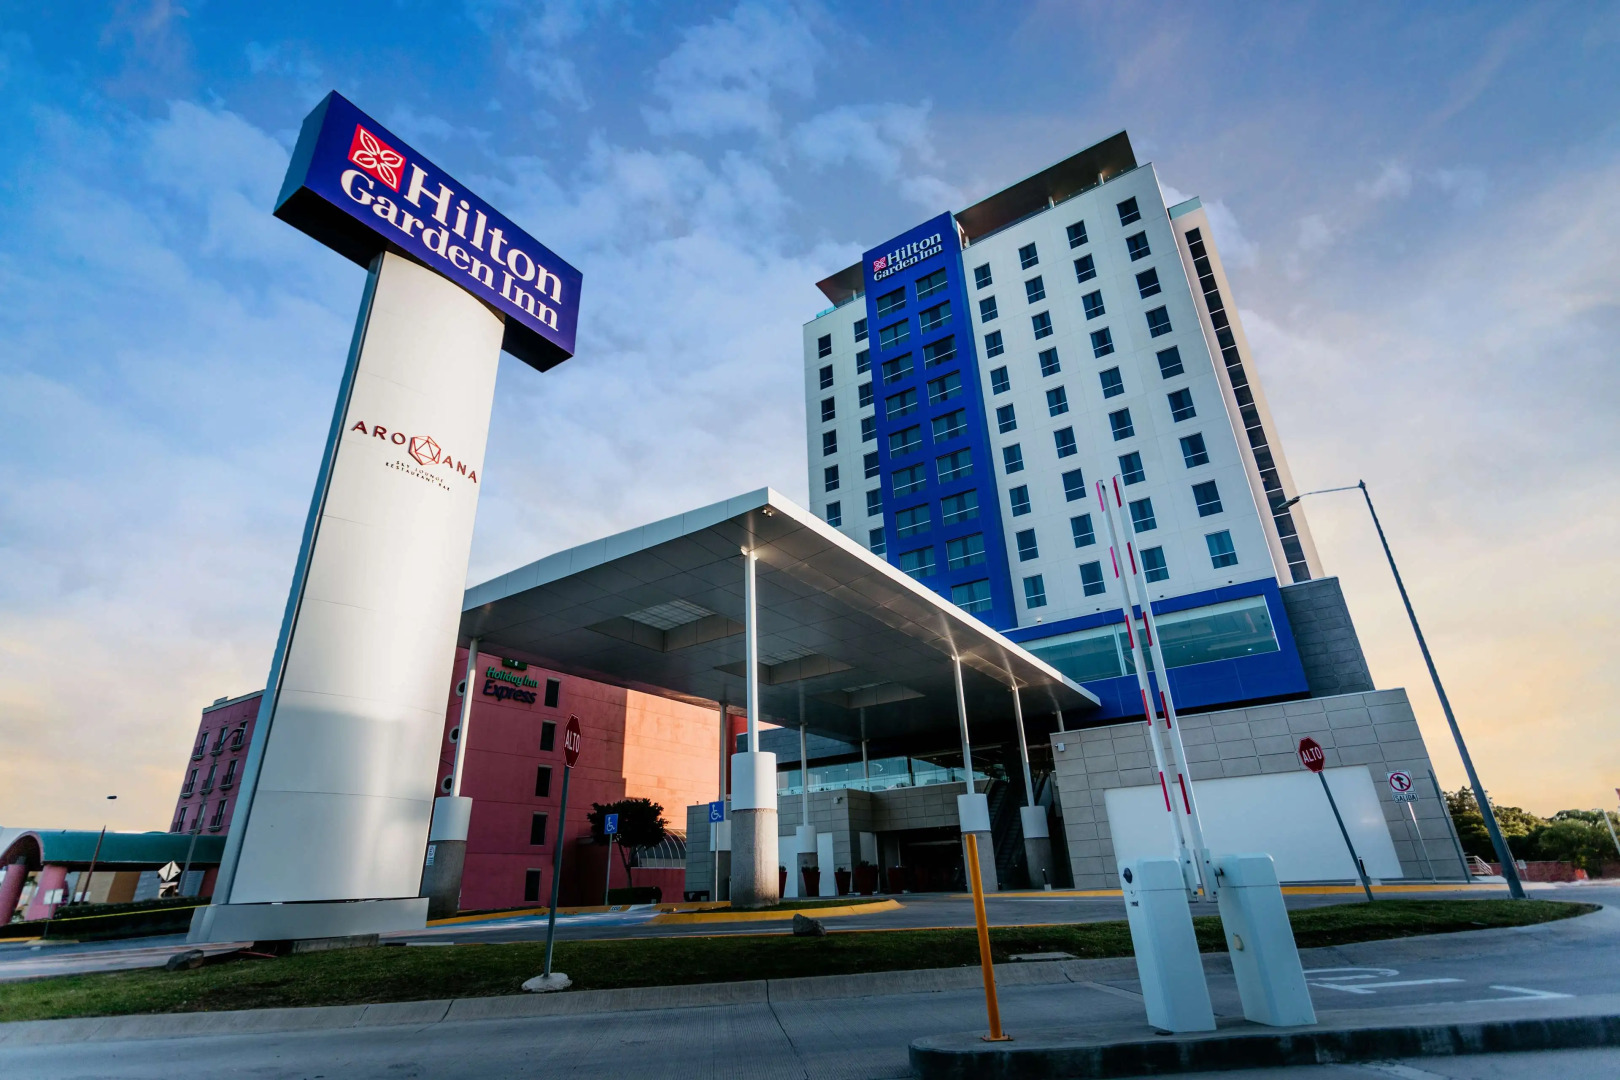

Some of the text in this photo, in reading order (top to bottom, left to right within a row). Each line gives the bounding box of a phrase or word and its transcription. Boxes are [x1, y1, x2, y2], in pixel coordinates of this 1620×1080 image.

[403, 163, 562, 304] Hilton
[340, 169, 559, 331] Garden Inn
[873, 244, 943, 281] Garden Inn
[886, 233, 942, 267] Hilton
[486, 666, 539, 688] Holiday Inn
[483, 679, 538, 704] Express
[564, 729, 580, 753] ALTO
[1301, 746, 1322, 763] ALTO
[1394, 794, 1417, 803] SALIDA
